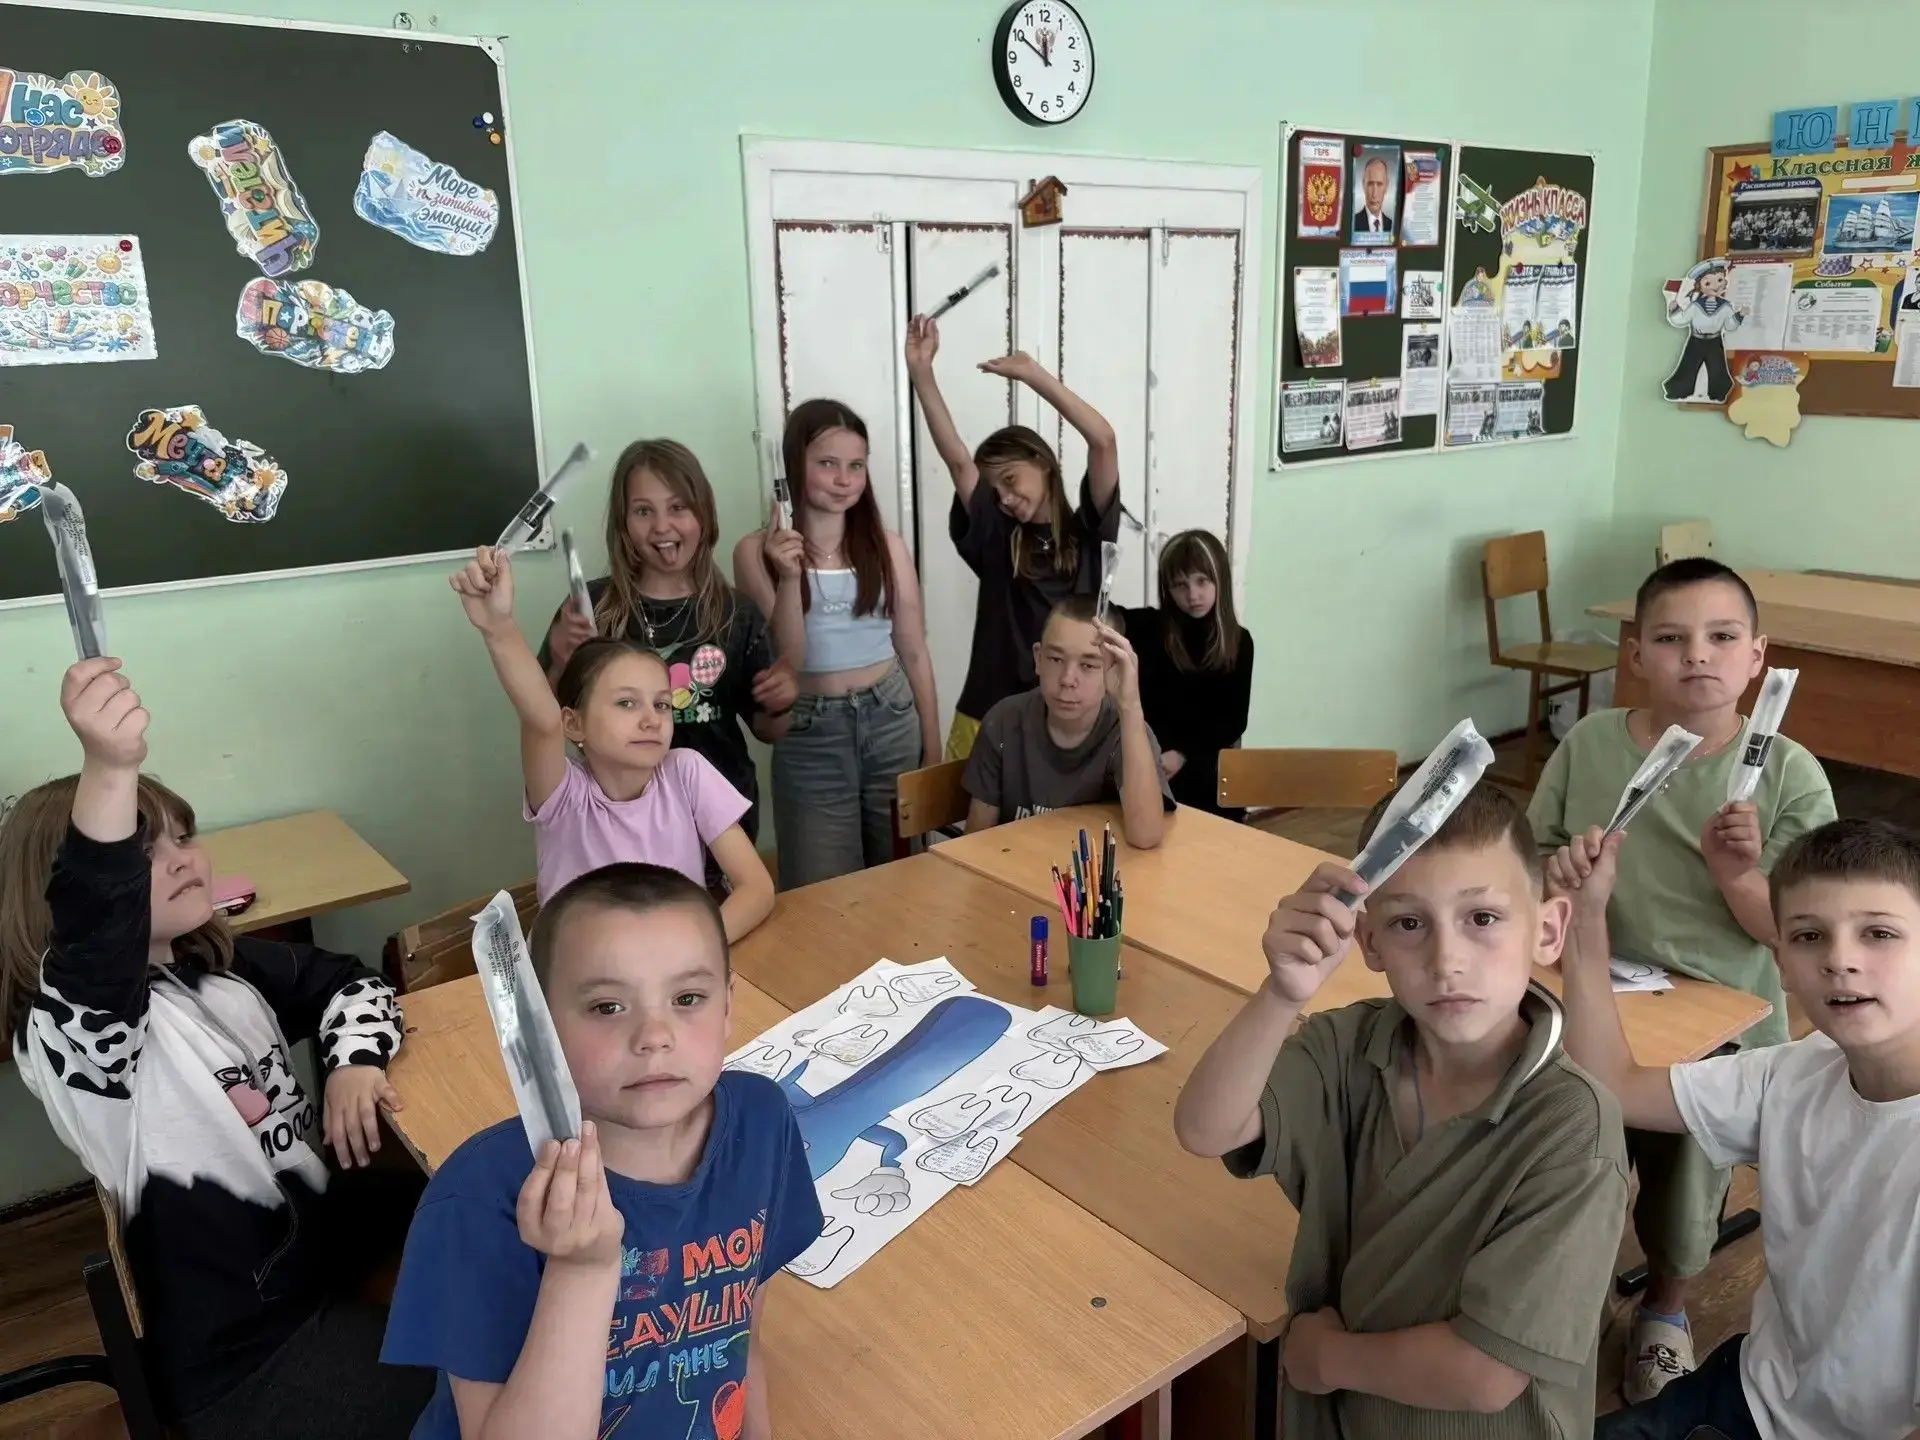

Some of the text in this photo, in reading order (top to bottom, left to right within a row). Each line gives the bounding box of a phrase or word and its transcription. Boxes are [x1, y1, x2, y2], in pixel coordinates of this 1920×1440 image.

[1025, 13, 1033, 26] 11
[1039, 9, 1050, 22] 12
[1058, 18, 1062, 30] 1
[1013, 28, 1024, 42] 10
[1068, 36, 1075, 49] 2
[1008, 51, 1017, 64] 9
[1072, 60, 1080, 72] 3
[1013, 75, 1021, 87] 8
[1067, 81, 1075, 94] 4
[1026, 92, 1033, 105] 7
[1056, 95, 1064, 108] 5
[1040, 100, 1049, 112] 6
[1772, 155, 1891, 177] Классная
[417, 165, 479, 200] Море
[1740, 178, 1816, 190] Расписание уроков
[416, 186, 492, 221] пзитивных
[419, 208, 491, 239] эмоций!
[1815, 280, 1852, 289] События
[668, 1338, 730, 1381] МНЕ
